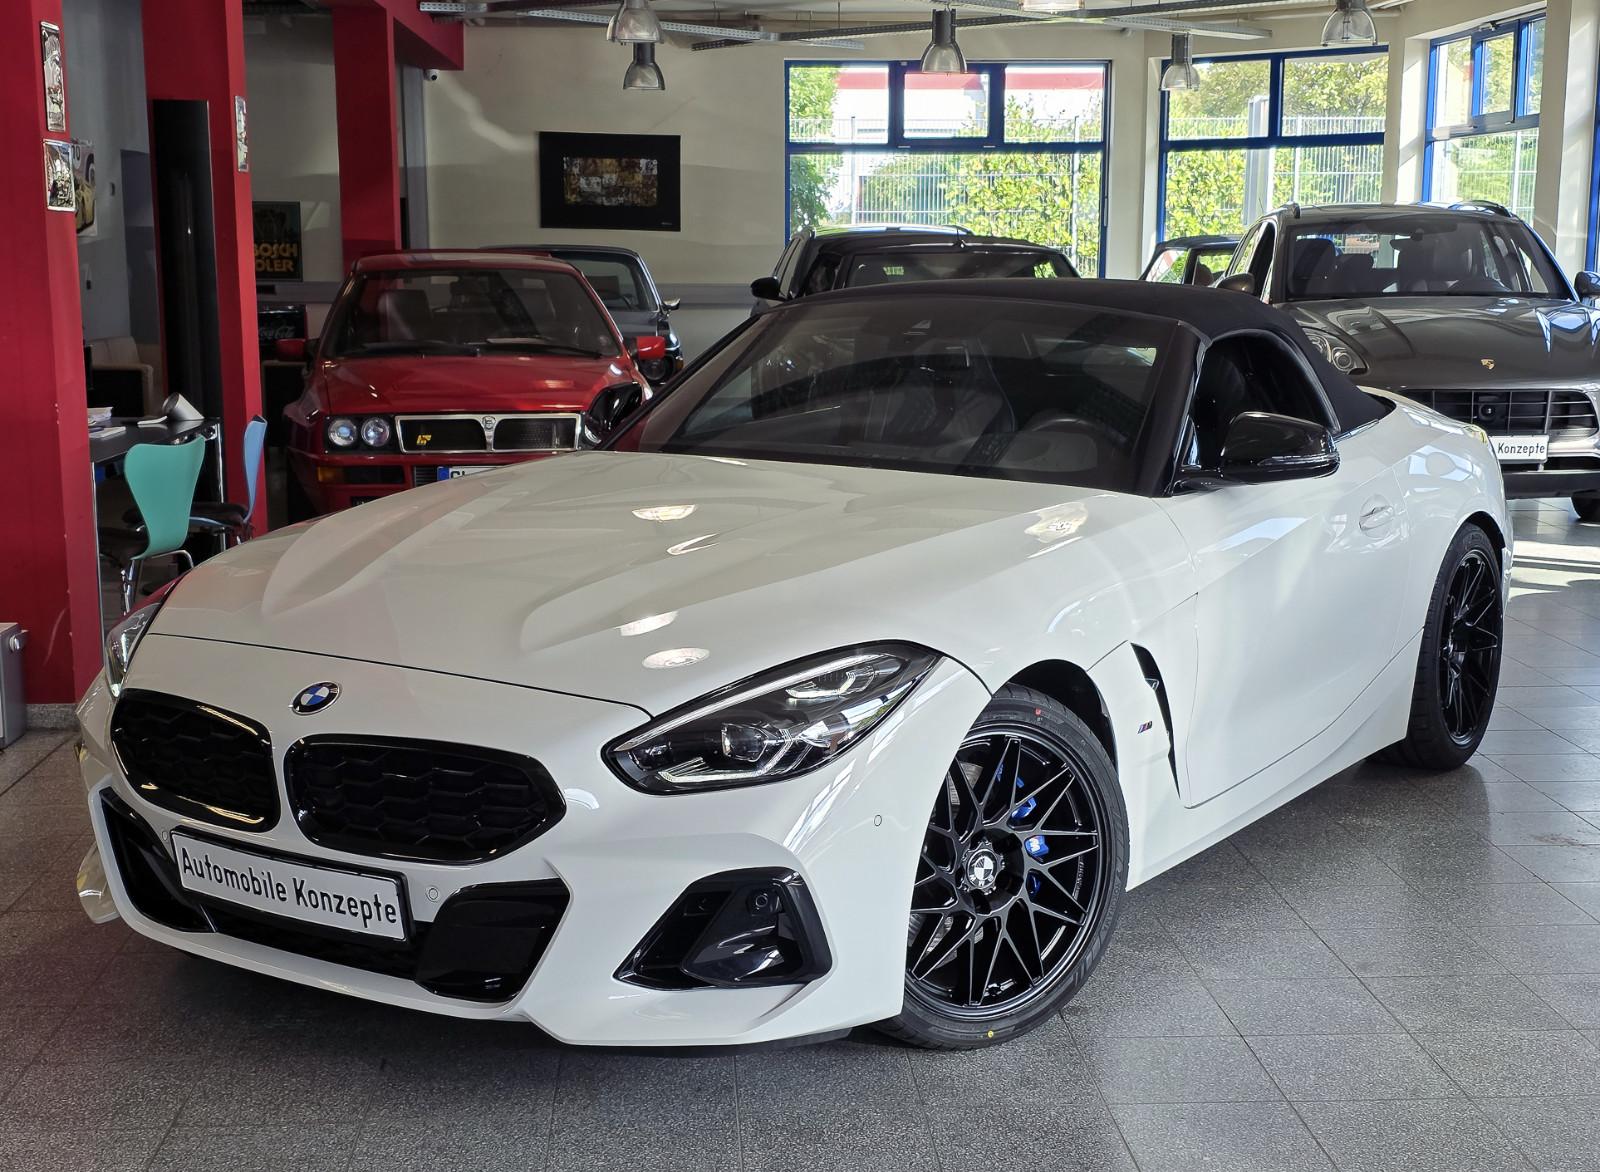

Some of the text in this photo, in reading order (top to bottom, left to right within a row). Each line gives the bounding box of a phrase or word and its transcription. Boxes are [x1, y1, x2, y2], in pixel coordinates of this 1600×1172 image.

[1497, 442, 1545, 456] Konzepte
[181, 847, 397, 928] Automobile Konzepte
